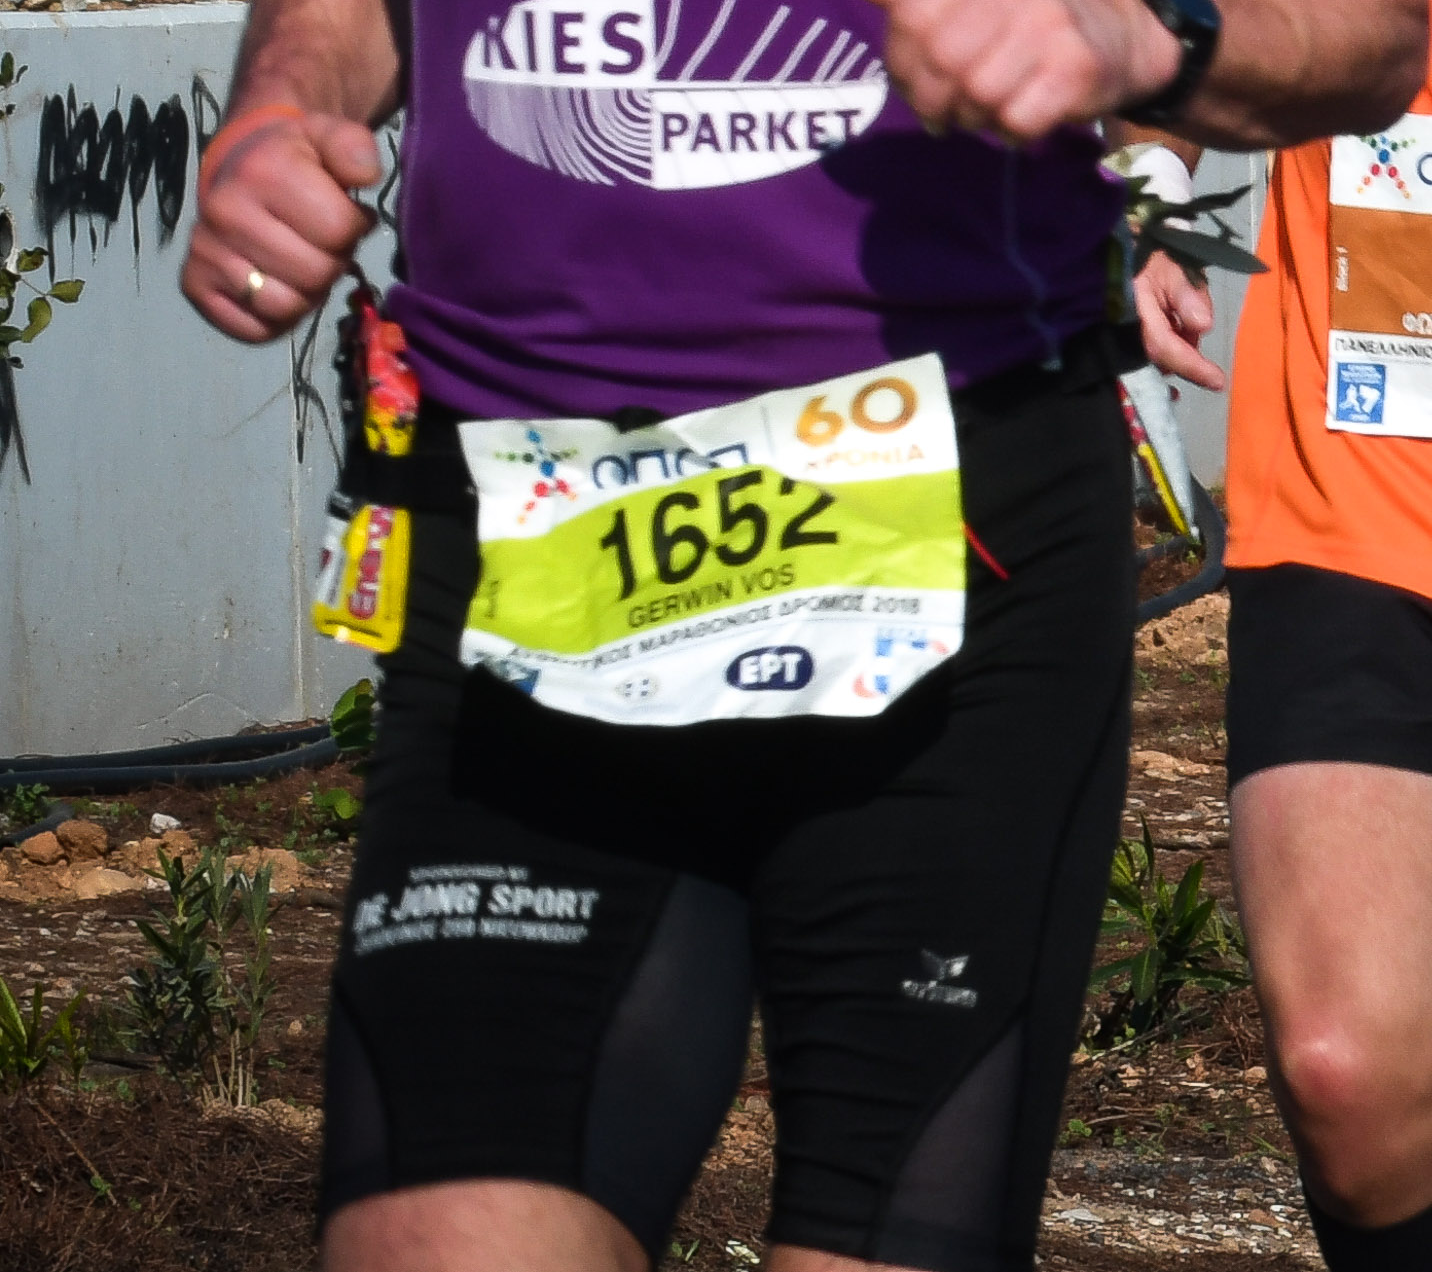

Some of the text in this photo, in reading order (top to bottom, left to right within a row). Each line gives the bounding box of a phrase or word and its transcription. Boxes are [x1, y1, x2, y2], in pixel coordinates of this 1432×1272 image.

[479, 10, 647, 75] KIES
[661, 107, 863, 153] PARKET
[795, 376, 920, 447] 60
[599, 469, 839, 602] 1652
[626, 564, 796, 630] GERWIN VOS
[487, 883, 600, 922] SPORT
